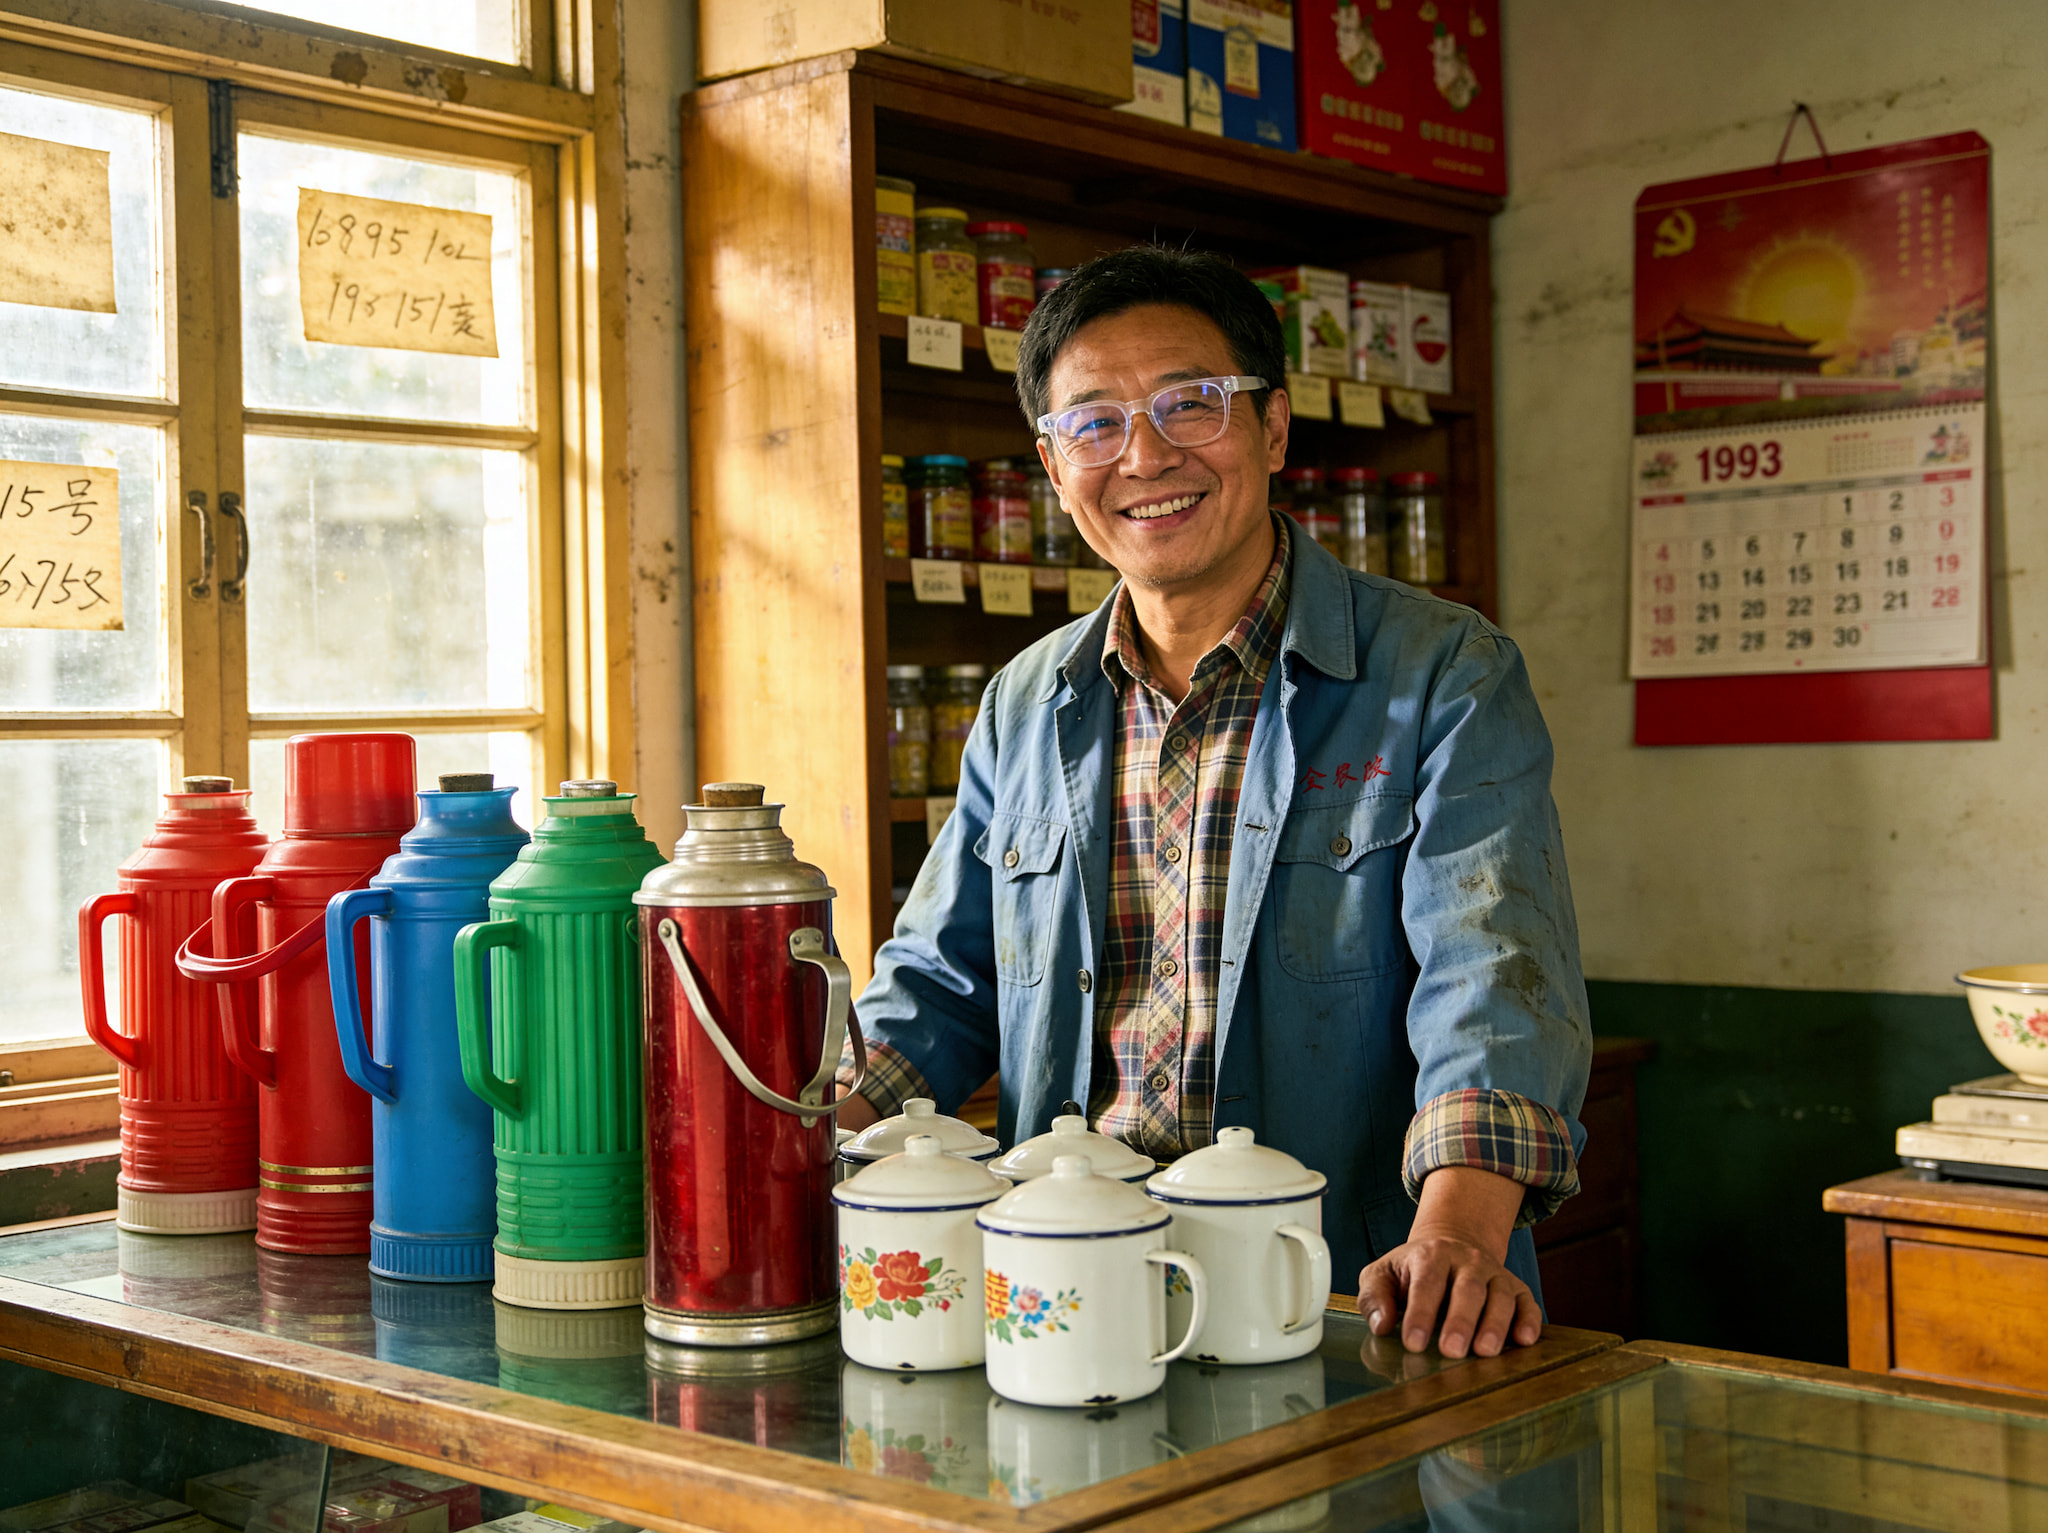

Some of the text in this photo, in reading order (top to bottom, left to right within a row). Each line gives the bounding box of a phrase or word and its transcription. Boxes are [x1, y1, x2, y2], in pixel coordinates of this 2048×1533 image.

[1695, 441, 1783, 483] 1993
[1843, 486, 1955, 514] 1 2 3
[1655, 543, 1670, 562] 4
[1702, 538, 1716, 560] 5
[1746, 535, 1760, 557] 6
[1792, 531, 1807, 552] 7
[1889, 525, 1903, 545] 9
[1934, 553, 1960, 574] 19
[1787, 595, 1812, 617] 22
[1834, 592, 1862, 615] 23
[1833, 625, 1861, 648] 30
